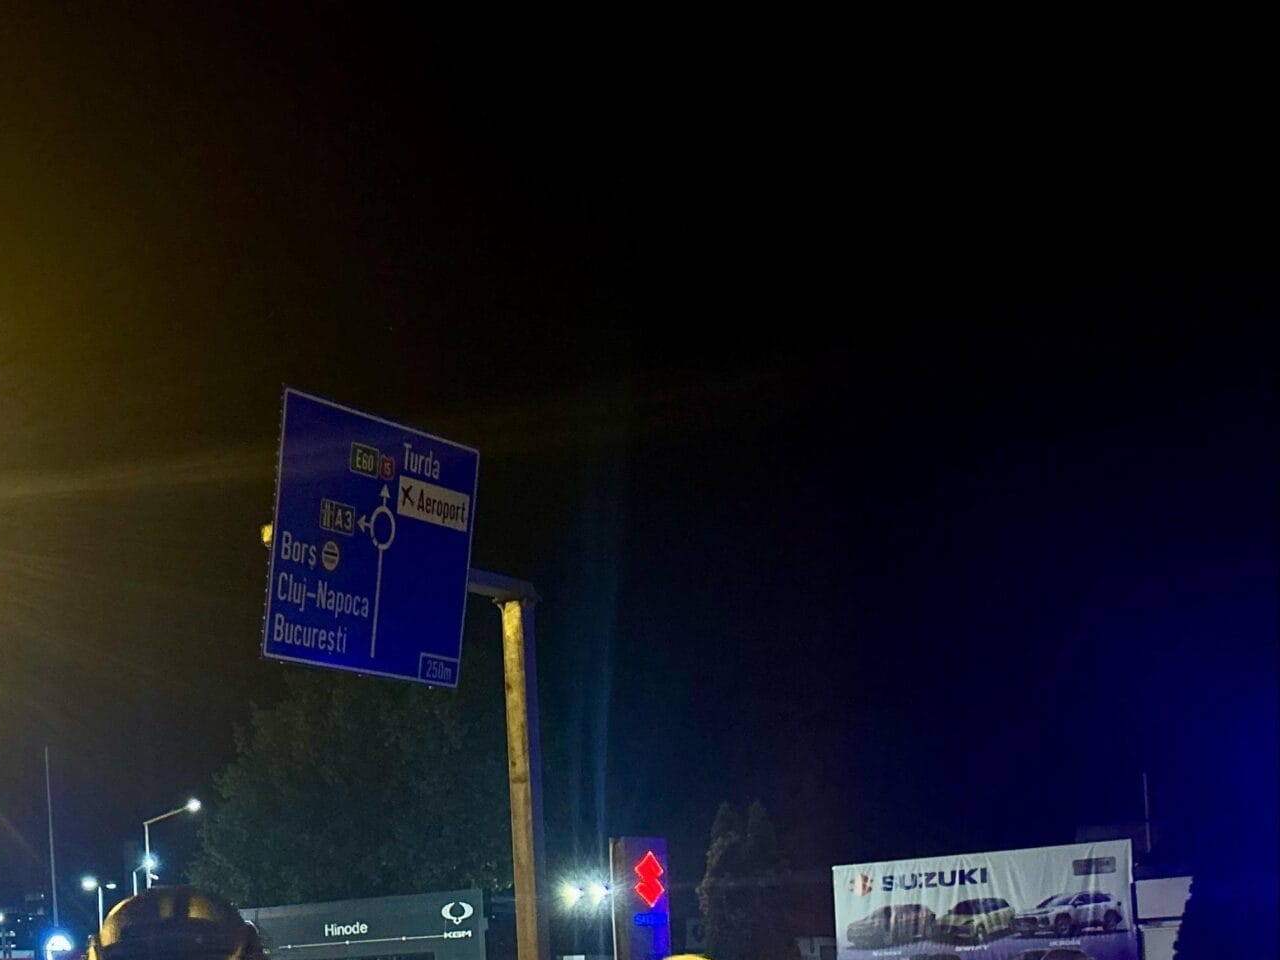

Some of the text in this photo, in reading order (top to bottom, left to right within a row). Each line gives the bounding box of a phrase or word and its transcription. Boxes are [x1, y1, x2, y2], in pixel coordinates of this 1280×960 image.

[355, 448, 374, 472] E60
[403, 442, 440, 479] Turda
[417, 489, 466, 524] Aeroport
[281, 530, 317, 570] Borș
[277, 571, 370, 619] Cluj-Napoca
[273, 612, 348, 656] București
[426, 659, 452, 681] 250m
[881, 867, 988, 892] SUZUKI
[324, 921, 369, 937] Hinode
[443, 930, 472, 939] KGM
